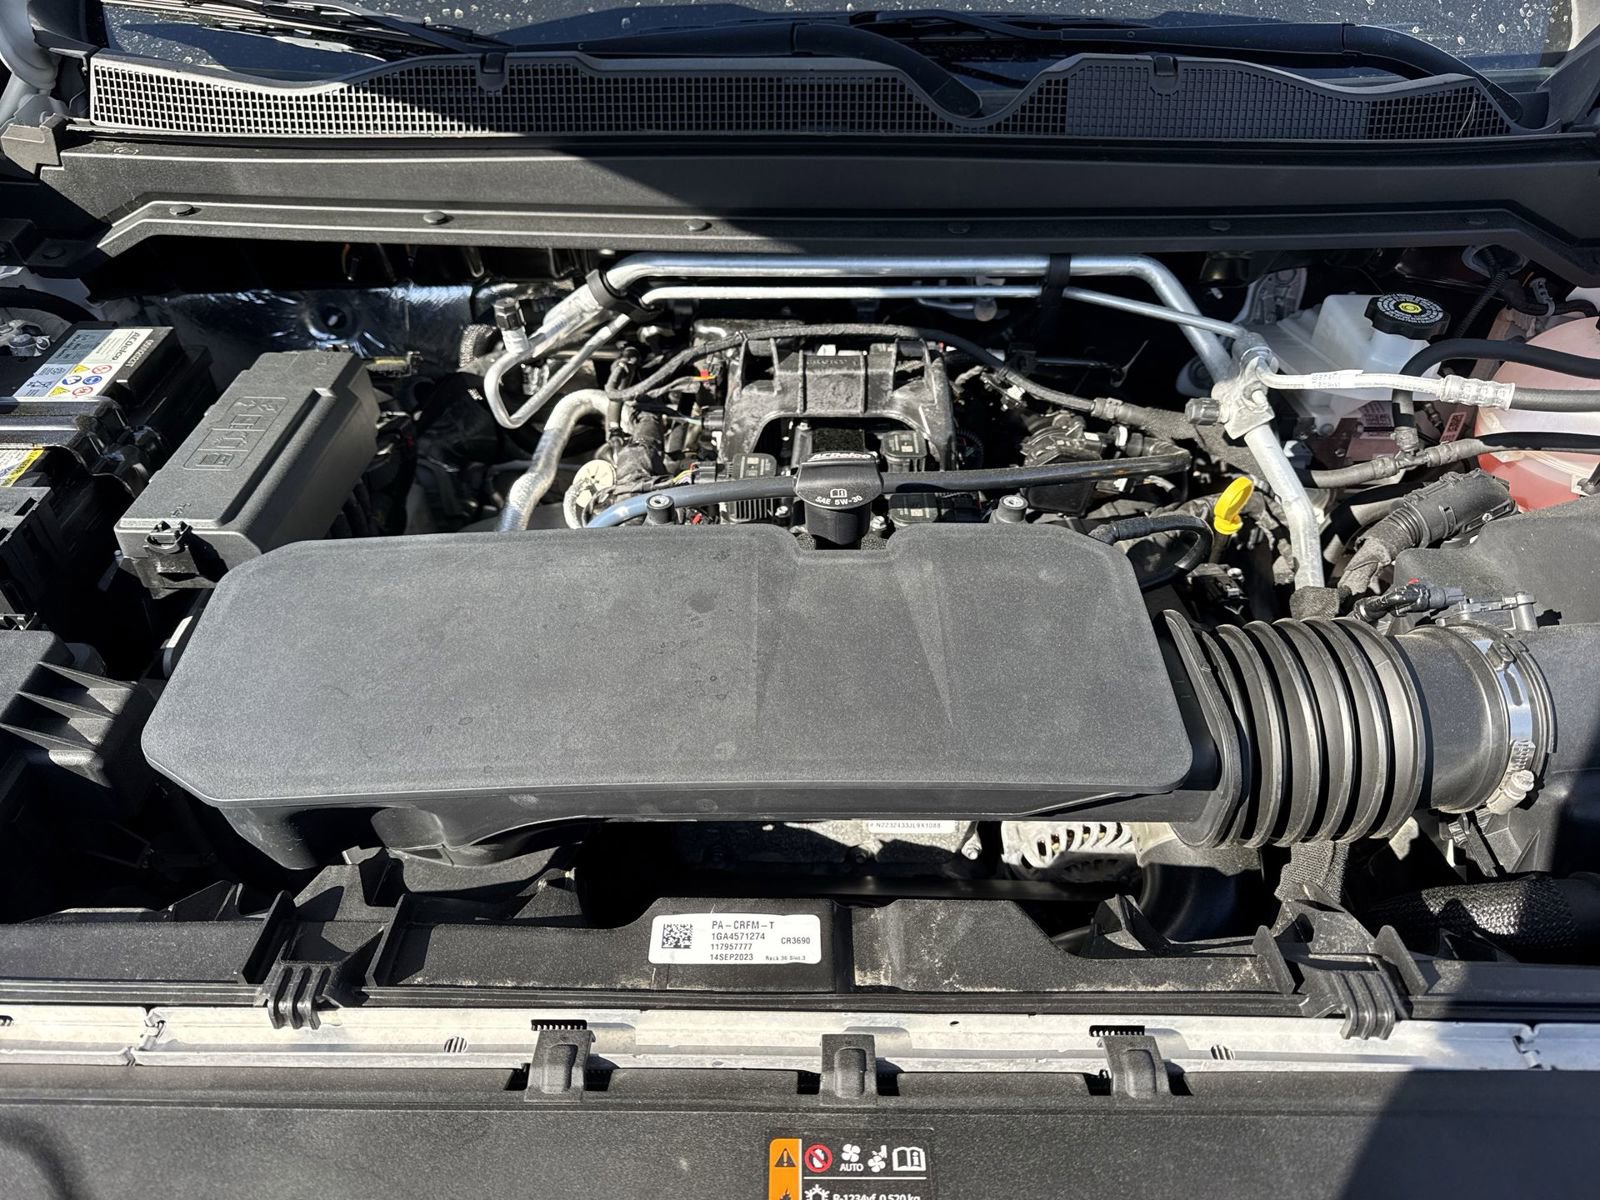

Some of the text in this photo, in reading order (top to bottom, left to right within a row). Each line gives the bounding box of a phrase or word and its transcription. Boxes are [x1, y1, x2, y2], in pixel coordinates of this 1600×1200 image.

[808, 452, 872, 462] ACDelco
[815, 495, 863, 506] SAE 5W-30
[711, 932, 766, 941] 1GA4571274
[780, 936, 811, 945] CR3690
[710, 942, 753, 951] 117957777
[709, 953, 754, 961] 14SEP2023
[839, 1163, 864, 1172] AUTO
